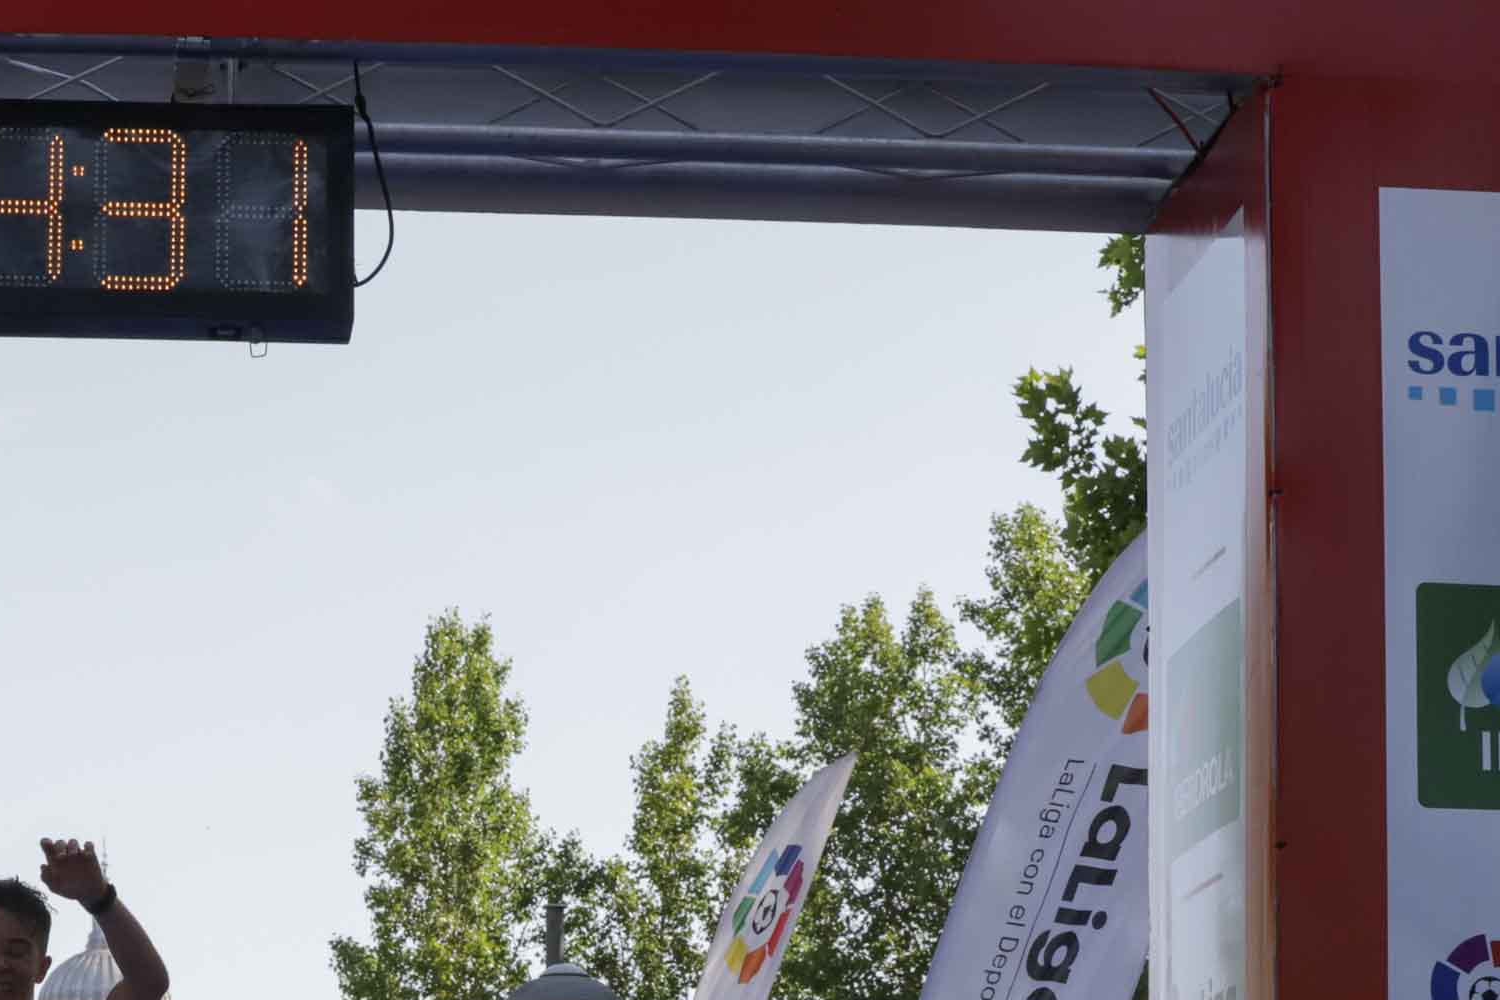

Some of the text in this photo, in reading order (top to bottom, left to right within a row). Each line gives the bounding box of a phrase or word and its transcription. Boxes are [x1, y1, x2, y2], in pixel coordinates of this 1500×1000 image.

[1408, 331, 1500, 376] sa
[1039, 758, 1085, 839] LaLiga
[1016, 848, 1045, 896] con
[1005, 904, 1026, 928] el
